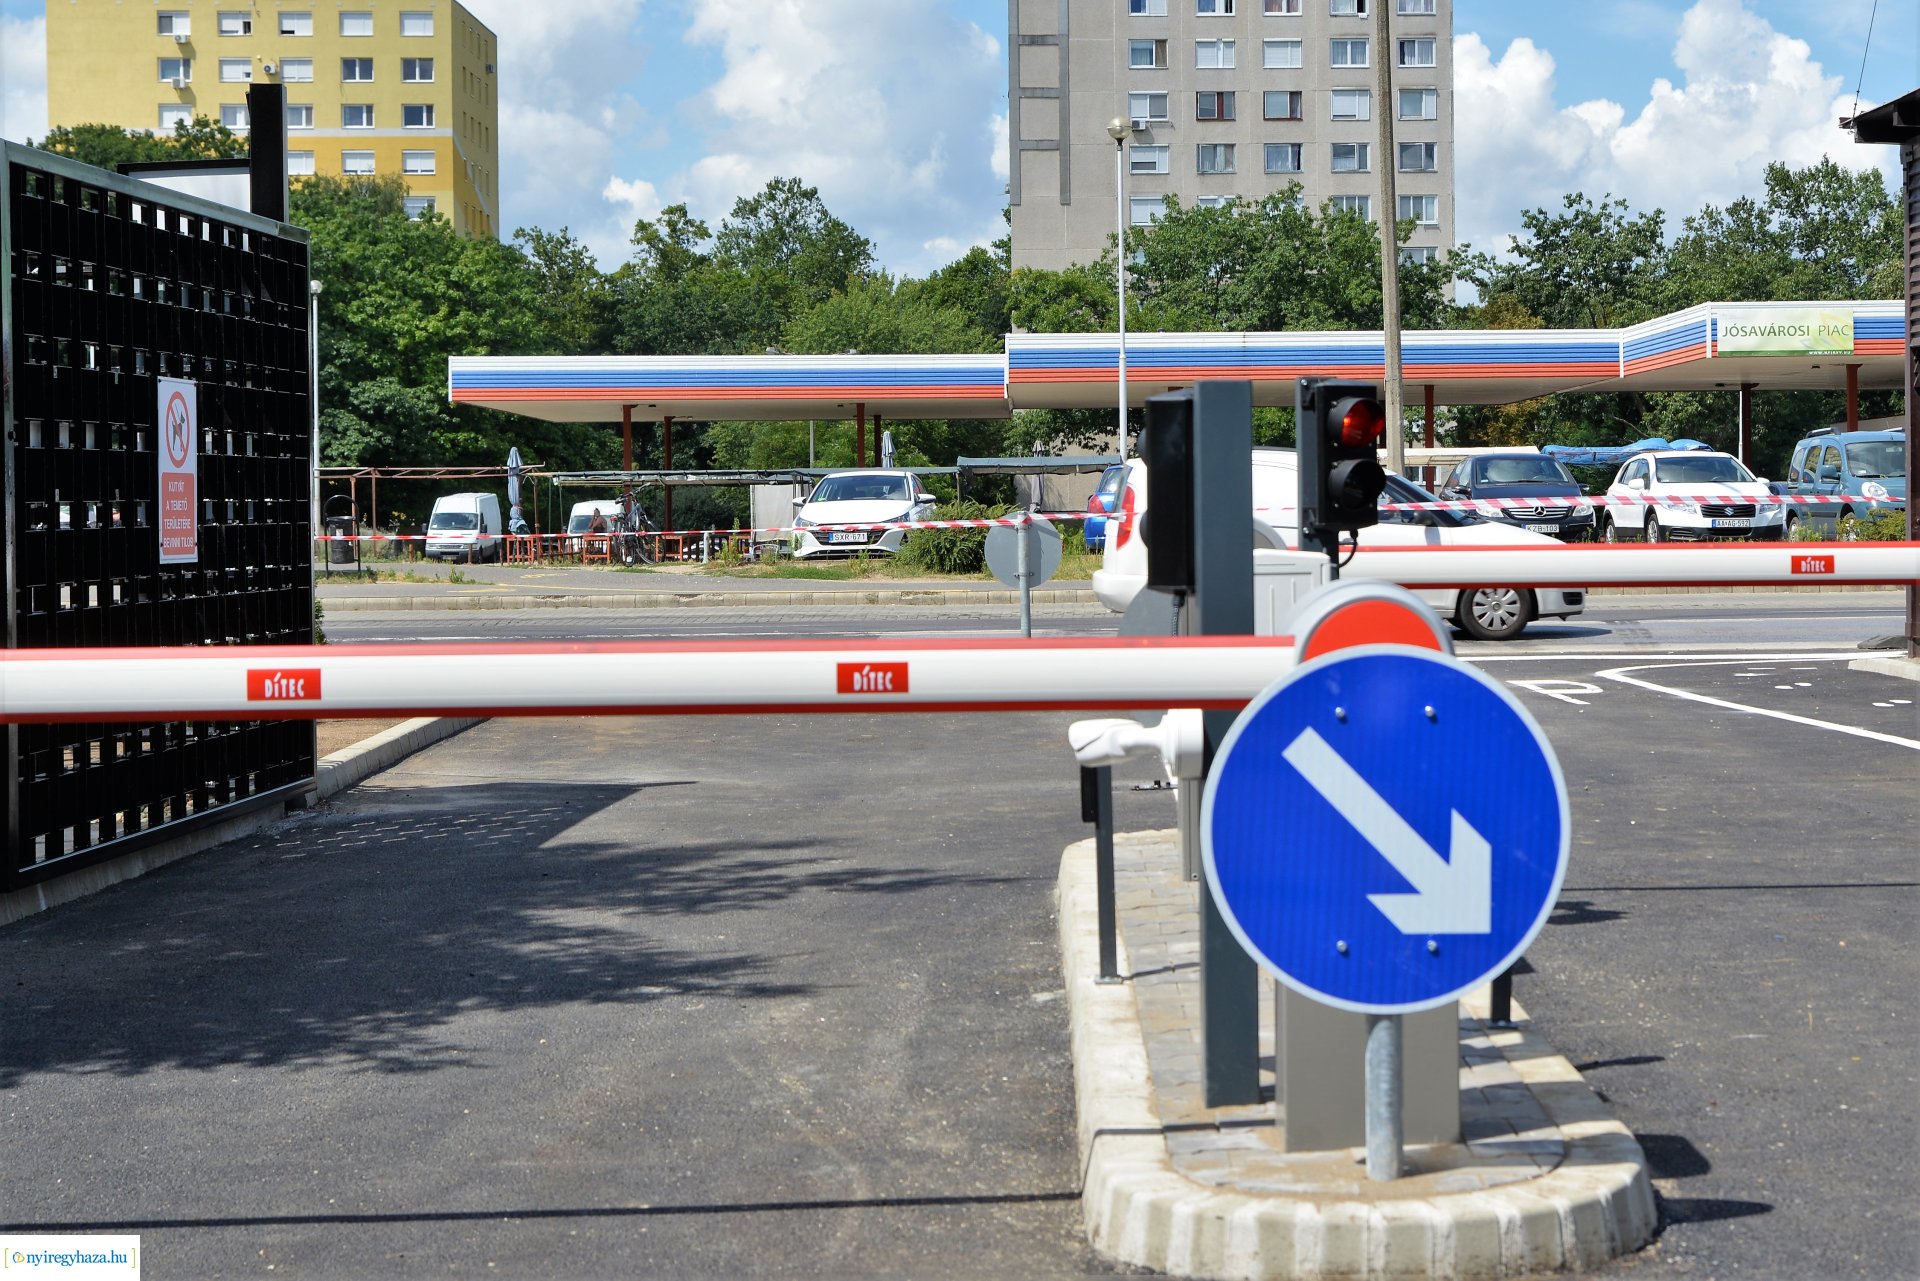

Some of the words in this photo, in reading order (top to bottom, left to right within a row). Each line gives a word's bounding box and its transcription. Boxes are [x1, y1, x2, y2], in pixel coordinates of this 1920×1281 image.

[1722, 323, 1810, 337] JÓSAVÁROSI
[1818, 324, 1850, 336] PIAC
[834, 533, 865, 541] SXR-671
